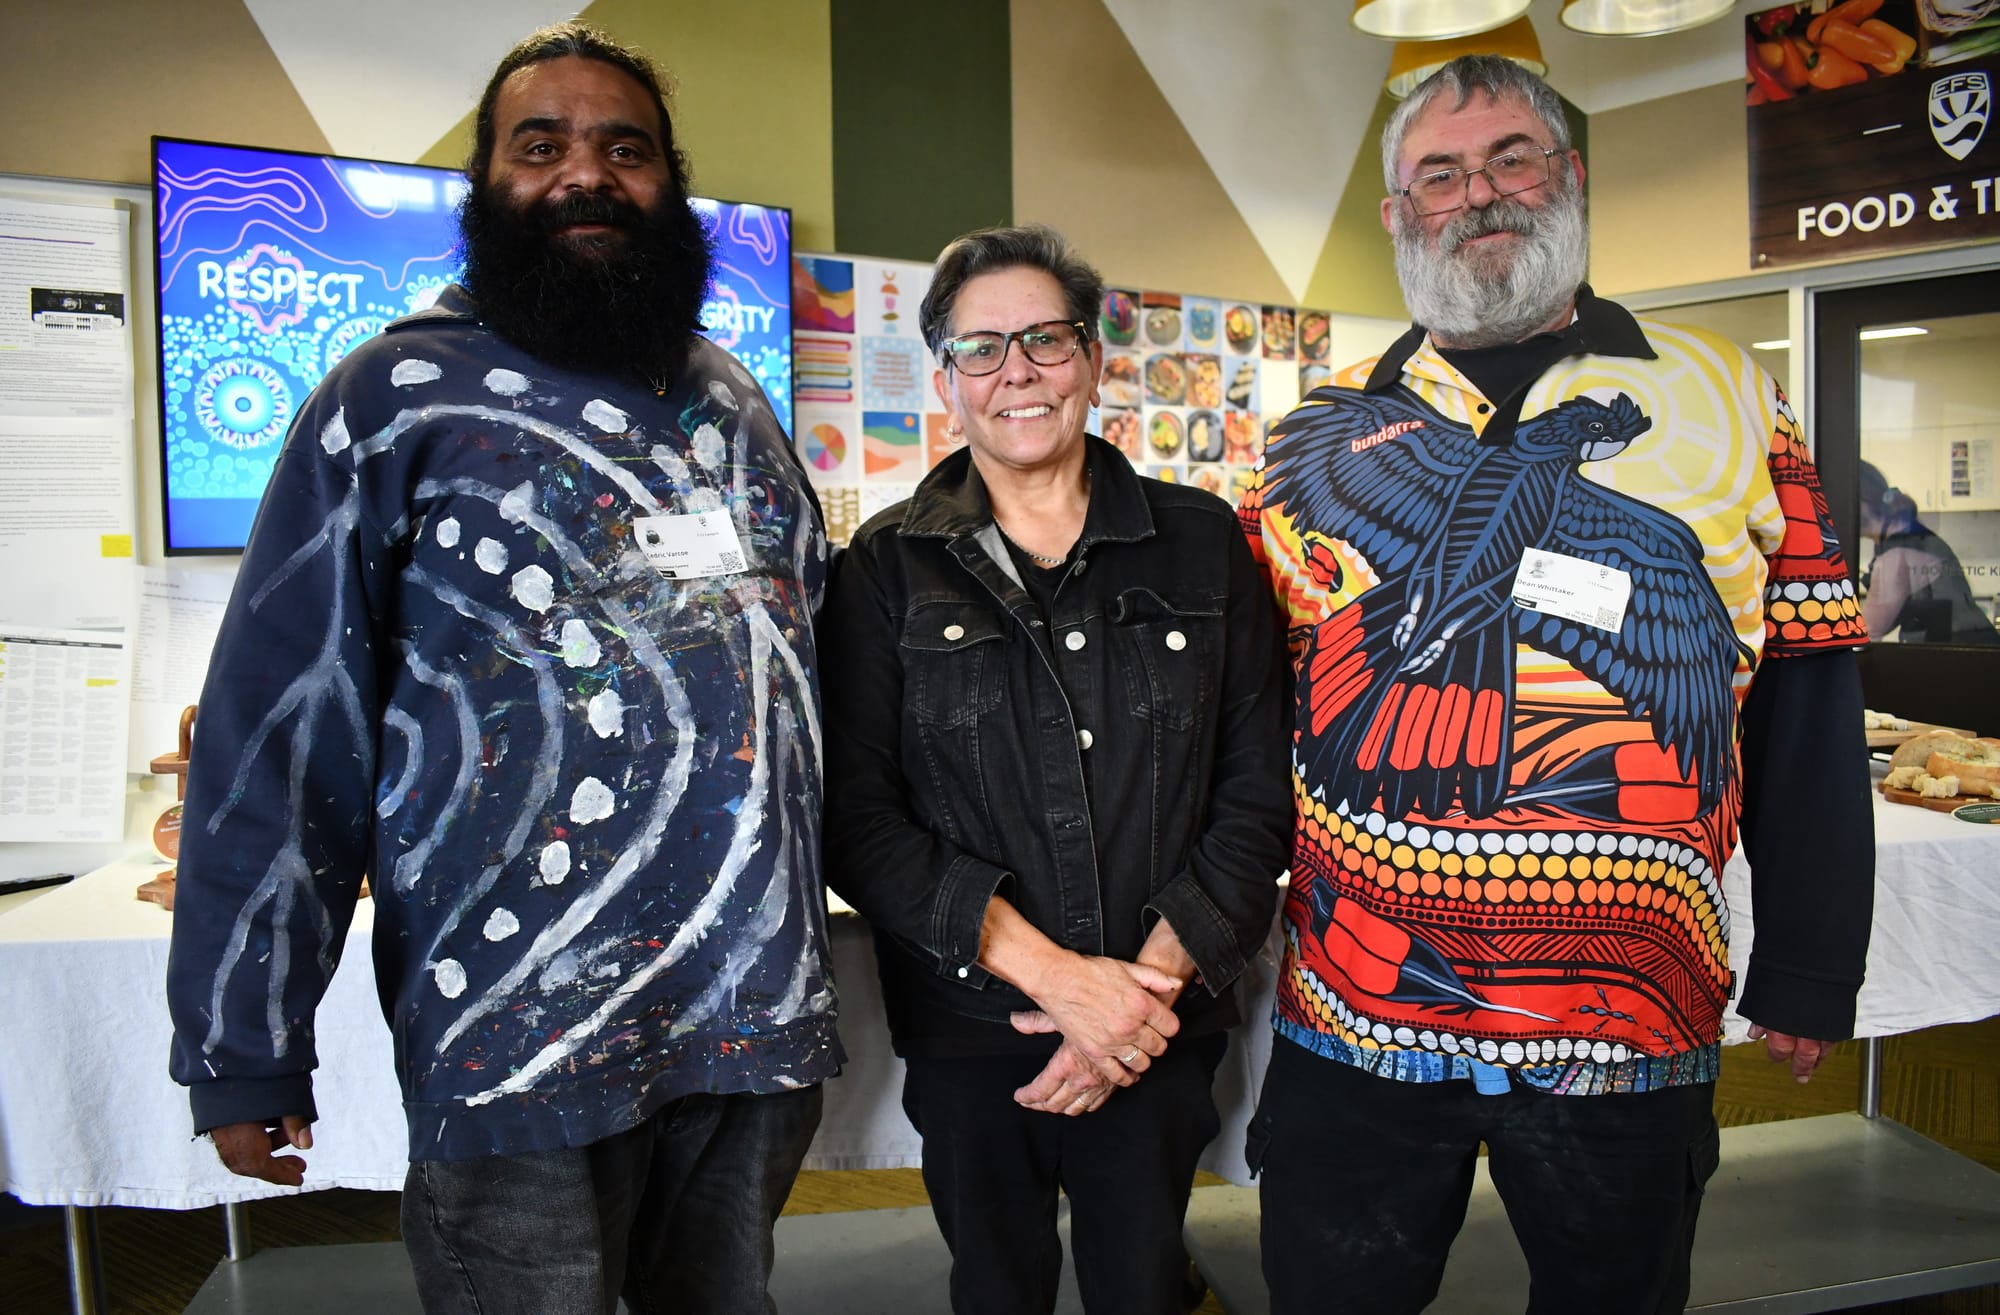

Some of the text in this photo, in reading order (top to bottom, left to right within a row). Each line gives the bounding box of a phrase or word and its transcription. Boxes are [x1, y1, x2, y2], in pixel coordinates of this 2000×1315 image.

[1934, 75, 1987, 98] EFS
[1797, 192, 1916, 241] FOOD
[1928, 184, 1959, 222] &
[197, 261, 365, 308] RESPECT
[699, 301, 775, 333] GRITY
[1351, 420, 1425, 453] bundarra
[1517, 578, 1536, 588] Dean
[1537, 583, 1575, 596] Whittaker
